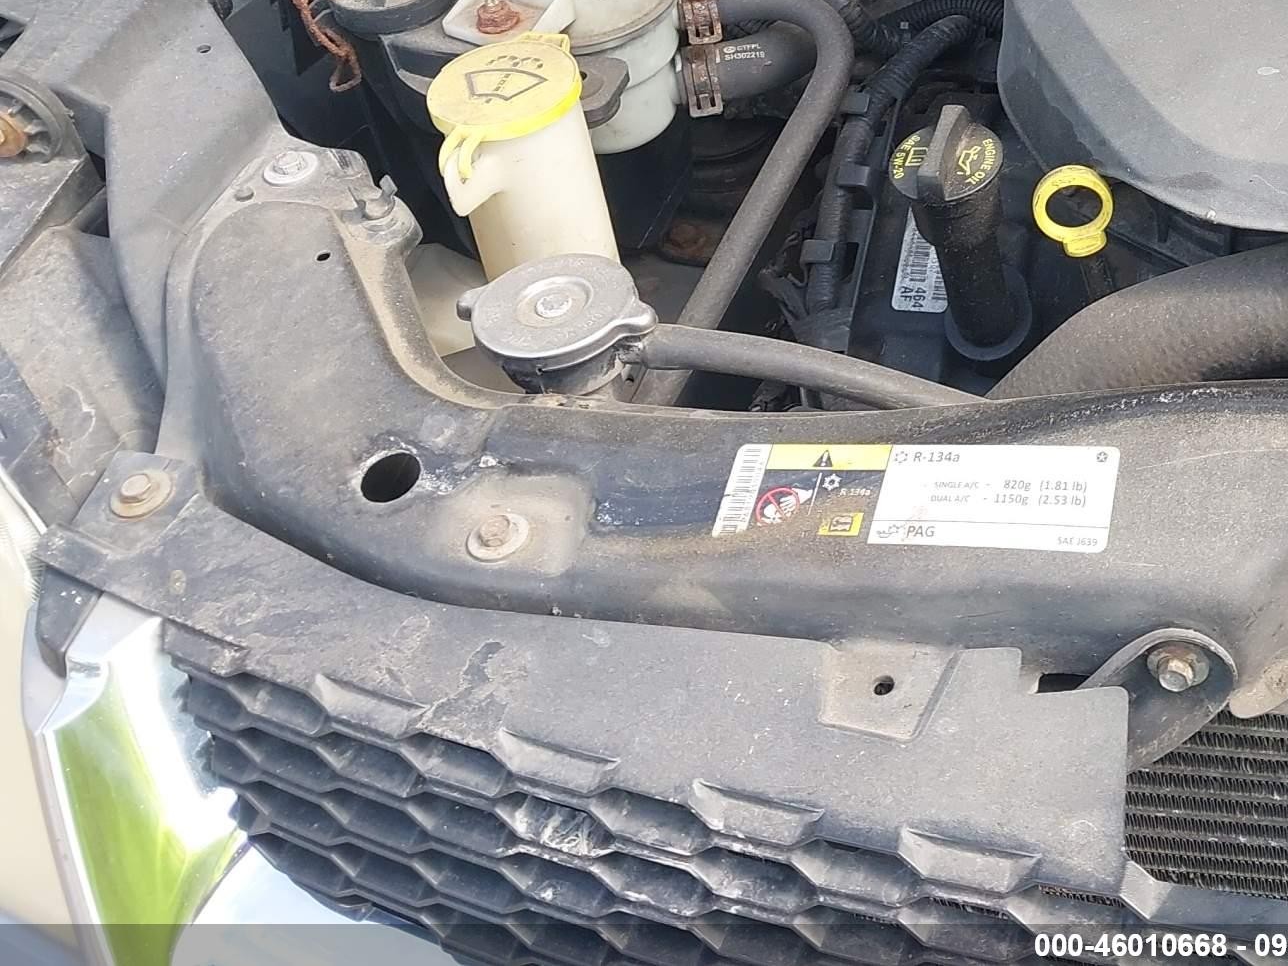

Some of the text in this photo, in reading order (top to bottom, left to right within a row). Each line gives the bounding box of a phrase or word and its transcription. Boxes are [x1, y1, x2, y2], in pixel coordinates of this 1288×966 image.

[893, 135, 921, 179] SAE 5W-20
[966, 139, 997, 185] ENGINE OIL
[900, 286, 913, 302] AF
[912, 287, 927, 308] 464
[913, 451, 960, 463] R-134a
[1003, 480, 1031, 492] 820g
[1039, 480, 1068, 492] (1.81
[1072, 481, 1088, 492] lb)
[994, 493, 1029, 506] 1150g
[1038, 494, 1067, 506] (2.53
[1073, 495, 1087, 507] lb)
[906, 525, 936, 538] PAG
[1057, 536, 1098, 546] SAE J639
